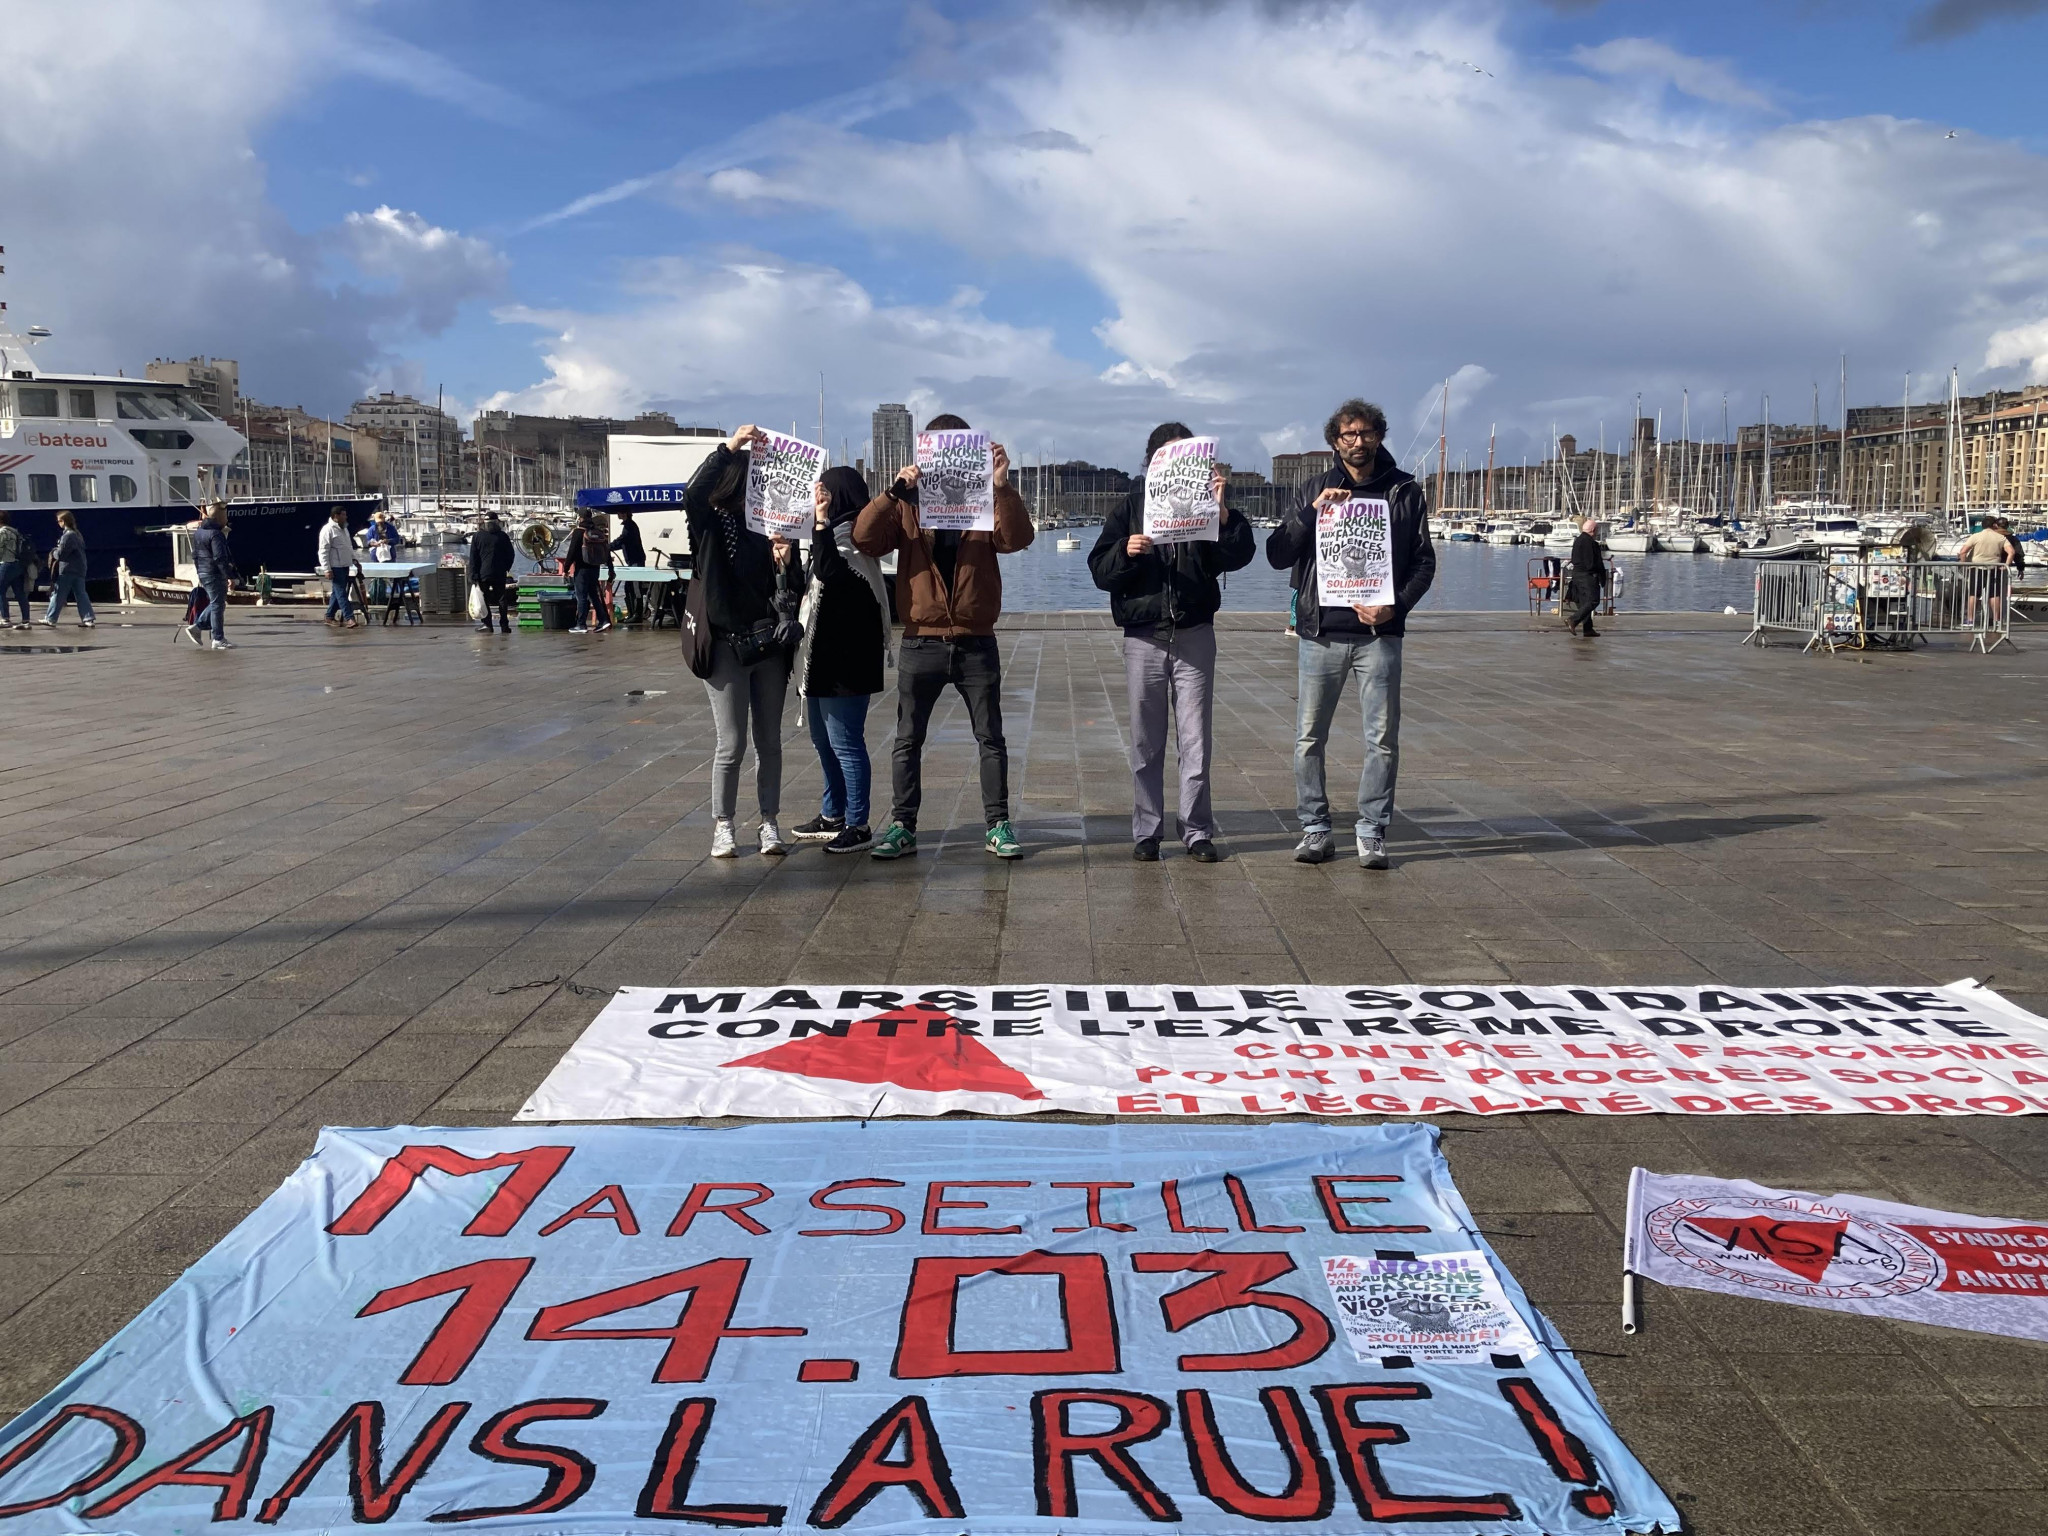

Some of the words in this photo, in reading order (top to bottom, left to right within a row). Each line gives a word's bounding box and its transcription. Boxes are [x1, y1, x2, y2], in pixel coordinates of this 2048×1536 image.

[24, 432, 107, 448] lebateau
[772, 436, 820, 459] NON!
[918, 433, 933, 447] 14
[938, 434, 983, 450] NON!
[933, 450, 941, 458] AU
[1169, 443, 1214, 459] NON!
[752, 459, 766, 467] AUX
[920, 462, 934, 470] AUX
[751, 472, 809, 491] VIOLENCES
[921, 469, 982, 490] VIOLENCES
[628, 490, 670, 502] VILLE
[674, 490, 684, 502] D
[1149, 478, 1210, 501] VIOLENCES
[227, 507, 257, 516] mond
[1320, 503, 1335, 518] 14
[1340, 503, 1383, 519] NON!
[1334, 520, 1343, 528] AU
[1320, 531, 1335, 539] AUX
[1321, 537, 1382, 562] VIOLENCES
[653, 988, 1308, 1013] MARSEILLE
[1344, 988, 1970, 1013] SOLIDAIRE
[647, 1018, 1049, 1039] CONTRE
[1079, 1013, 1615, 1037] L'EXTRÊME
[1638, 1016, 2010, 1037] DROITE
[1561, 1043, 1657, 1059] LE
[1673, 1043, 2048, 1060] FASCISME
[1358, 1066, 1446, 1083] LE
[1465, 1065, 1811, 1085] PROGRÈS
[1829, 1067, 2048, 1085] SOCA
[1117, 1093, 1200, 1113] ET
[1671, 1093, 1833, 1113] DES
[1682, 1222, 1893, 1258] VISA
[1324, 1257, 1358, 1272] 14
[1368, 1258, 1470, 1275] NON!
[1692, 1257, 1870, 1297] SYNDICALES
[1341, 1292, 1481, 1315] VIOLENCES
[1369, 1306, 1387, 1317] D'
[355, 1249, 1336, 1386] 14.03
